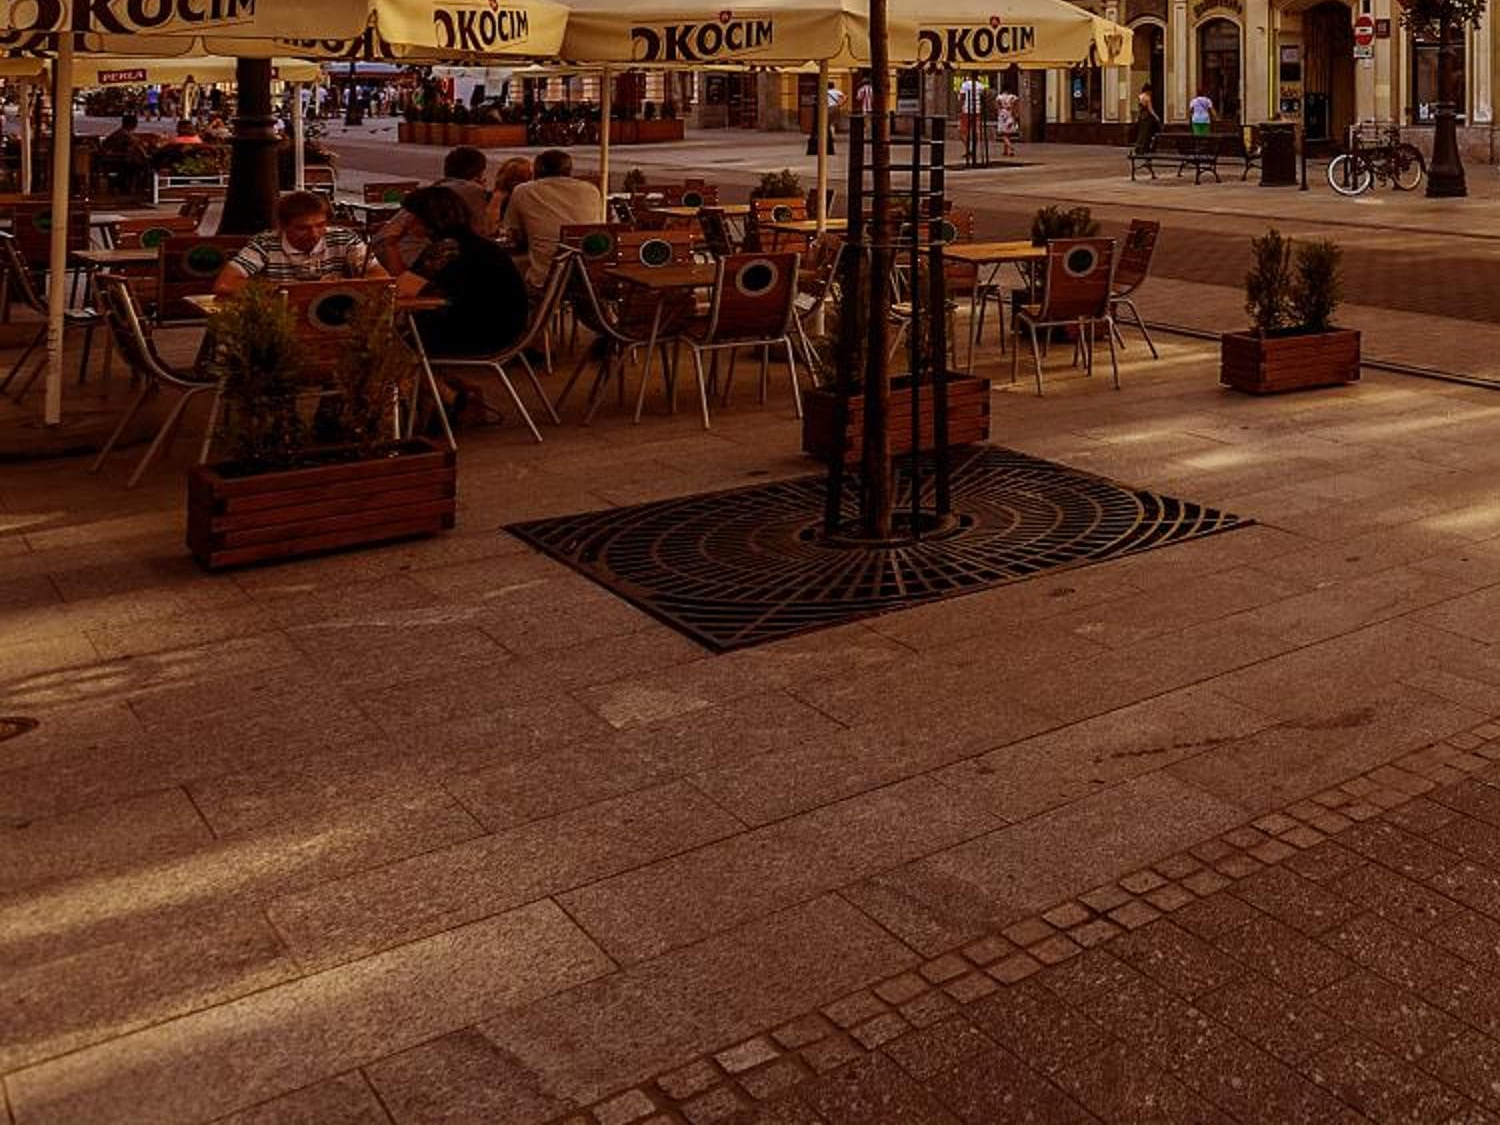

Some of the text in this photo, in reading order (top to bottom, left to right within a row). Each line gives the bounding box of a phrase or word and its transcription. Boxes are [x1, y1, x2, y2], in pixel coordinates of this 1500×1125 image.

[433, 9, 529, 52] OKOCIM
[631, 19, 773, 61] OKOCIM
[917, 25, 1035, 62] OKOCIM
